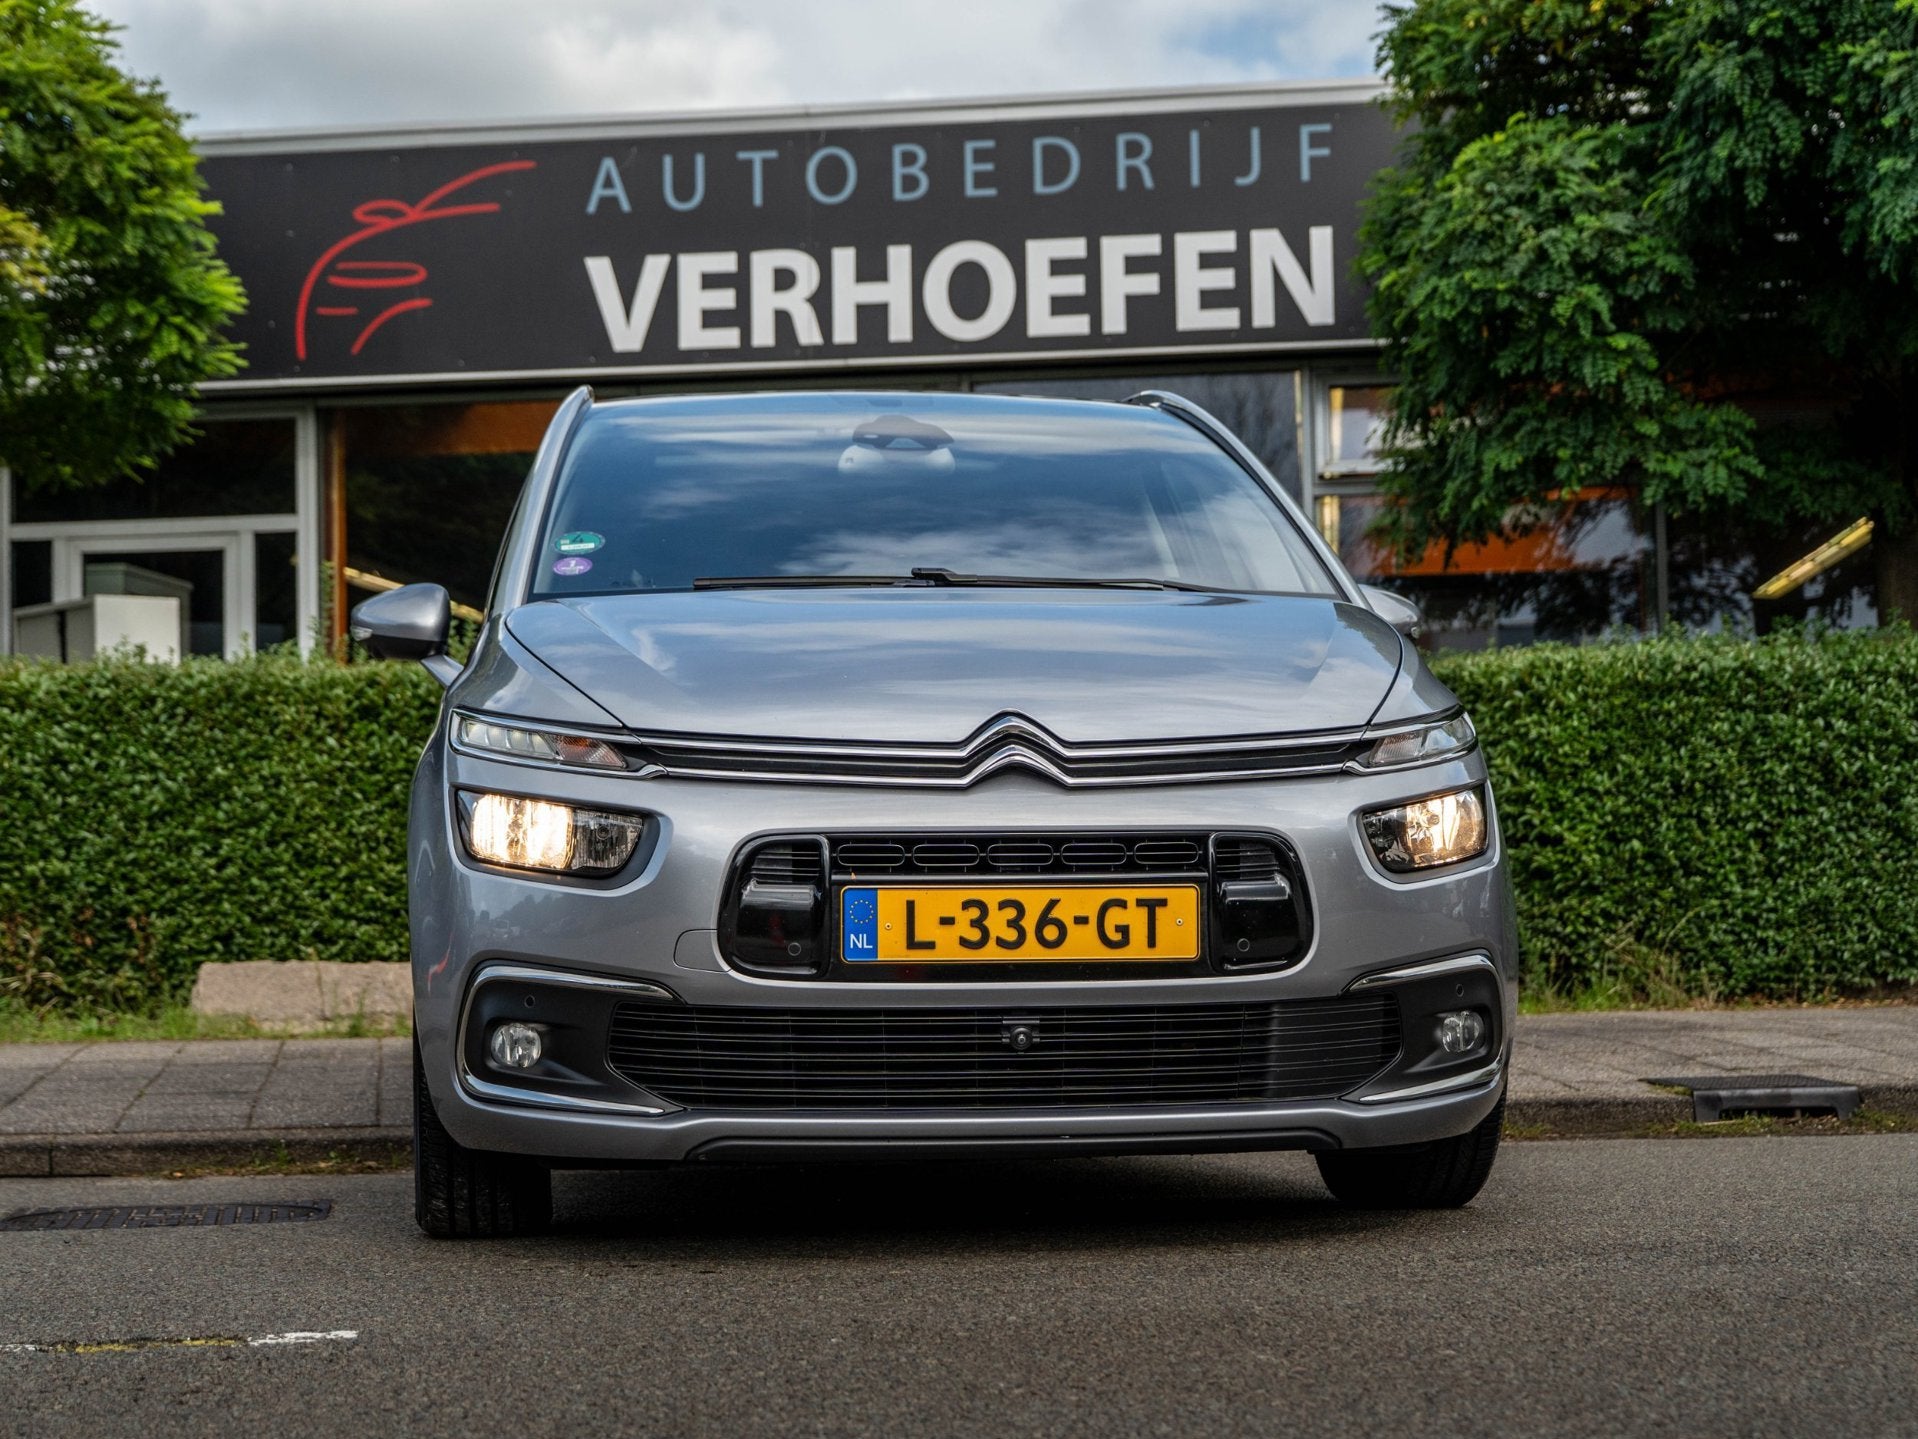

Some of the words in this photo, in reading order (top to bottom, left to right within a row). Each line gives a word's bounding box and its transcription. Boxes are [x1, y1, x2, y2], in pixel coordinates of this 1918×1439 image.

[585, 124, 1333, 214] AUTOBEDRIJF
[583, 226, 1336, 354] VERHOEFEN
[849, 934, 873, 949] NL
[905, 897, 1169, 951] L-336-GT
